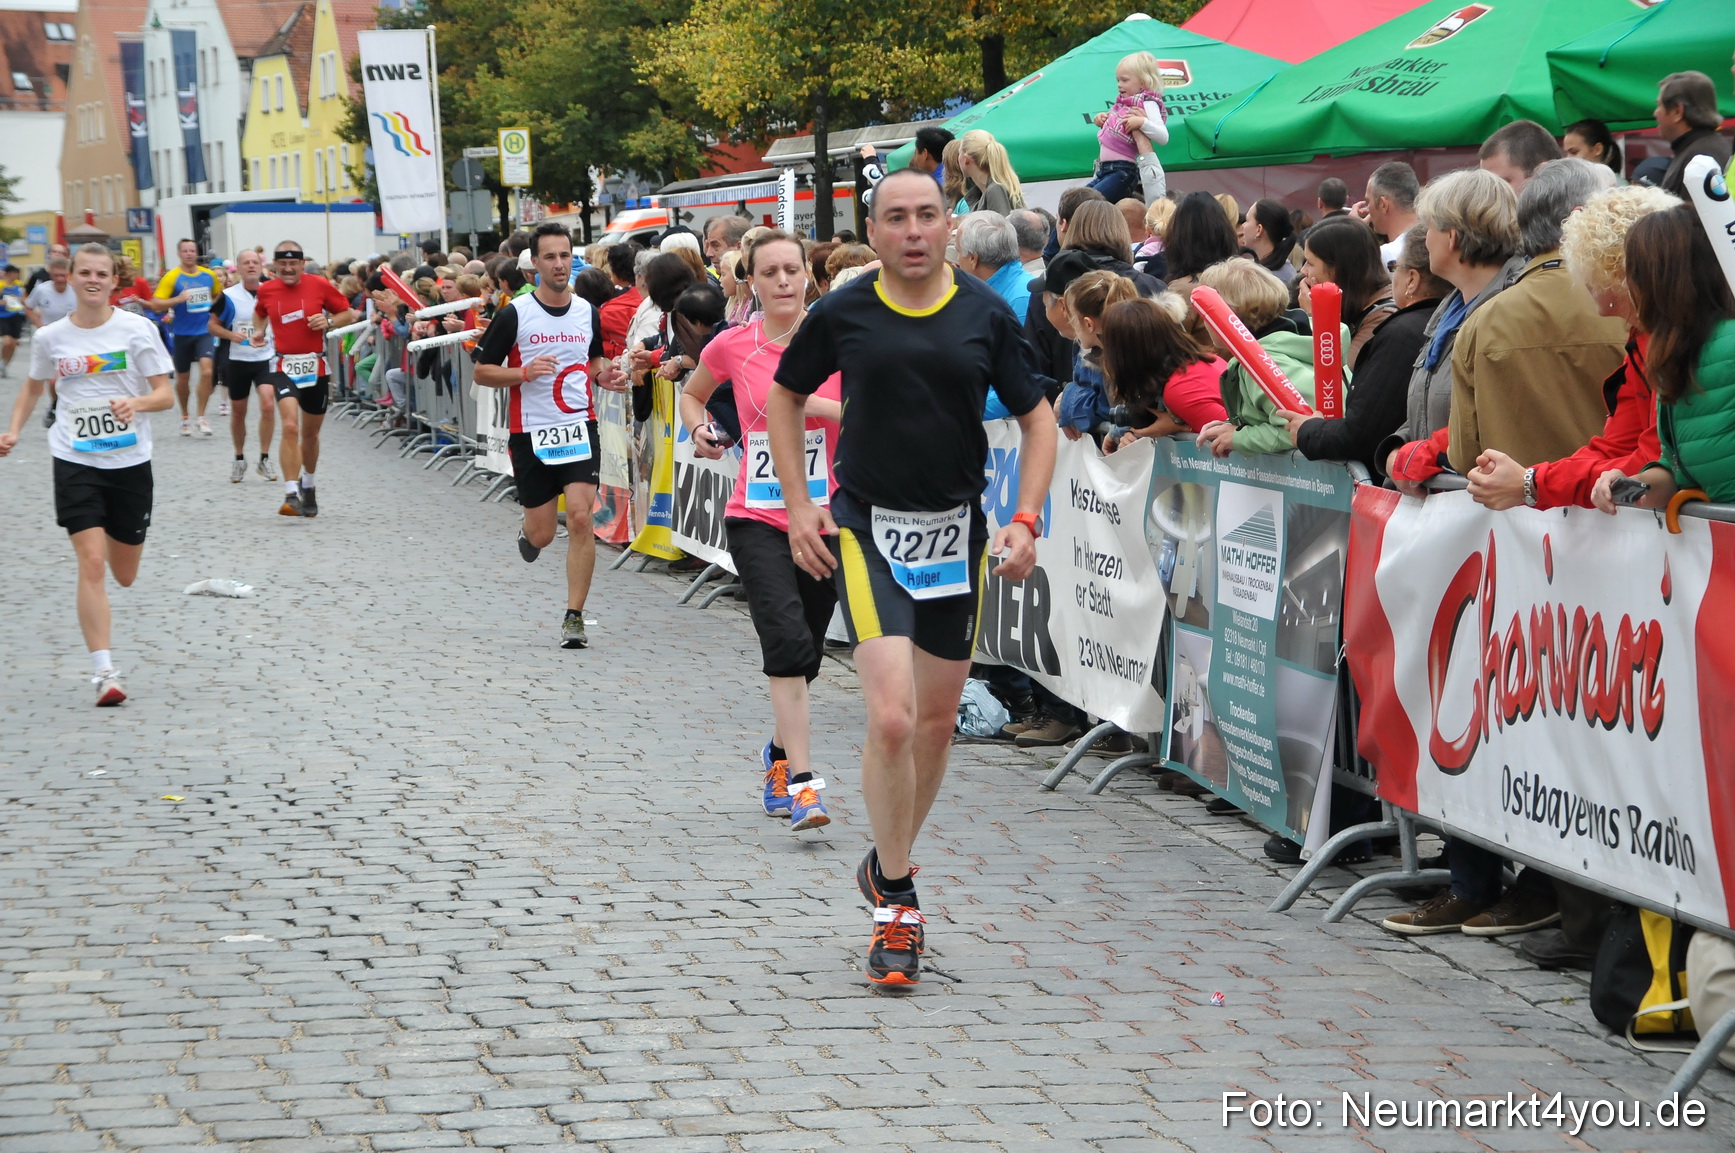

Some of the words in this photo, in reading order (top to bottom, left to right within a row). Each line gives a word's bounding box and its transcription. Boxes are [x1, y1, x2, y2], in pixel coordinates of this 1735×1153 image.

[529, 332, 586, 344] Oberbank
[286, 361, 315, 375] 2662
[1258, 351, 1284, 379] BKK
[1281, 378, 1308, 405] Audi
[1323, 379, 1335, 409] BKK
[537, 425, 583, 446] 2314
[547, 447, 576, 458] Michael
[1316, 479, 1335, 497] Bayern
[874, 514, 910, 525] PARTL
[912, 513, 956, 527] Neumarkt
[885, 523, 961, 564] 2272
[1084, 540, 1123, 580] Herzen
[1221, 544, 1244, 567] MATHI
[1245, 550, 1277, 576] HOFFER
[907, 571, 941, 587] Holger
[1089, 581, 1114, 619] Stadt
[1428, 528, 1672, 776] Charivari
[1229, 700, 1257, 725] Trockenbau
[1246, 766, 1281, 793] Sanierungen
[1502, 764, 1620, 850] Ostbayerns
[1626, 804, 1696, 876] Radio
